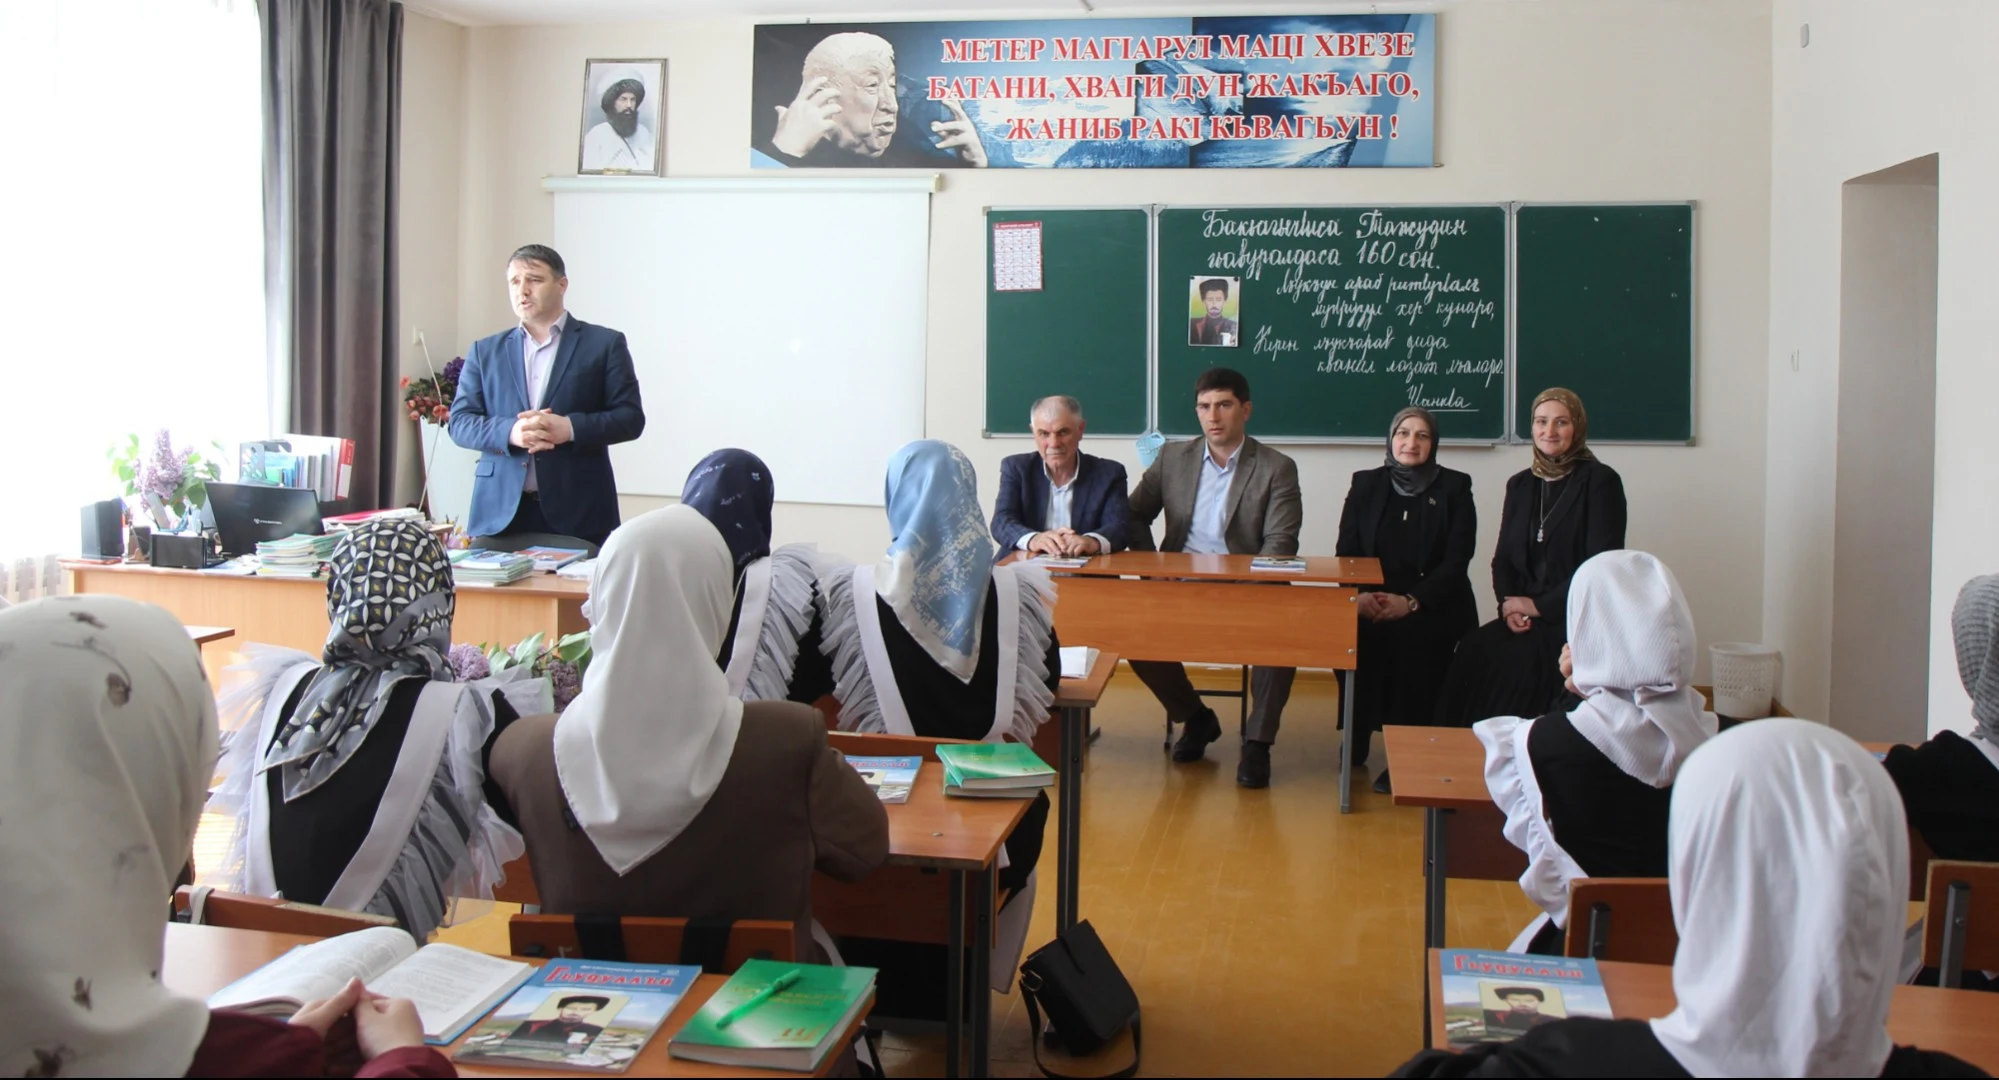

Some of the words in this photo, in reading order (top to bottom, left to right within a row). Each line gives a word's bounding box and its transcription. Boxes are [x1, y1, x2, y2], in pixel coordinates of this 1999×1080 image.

[941, 38, 1046, 62] МЕТЕР
[1313, 33, 1414, 58] ХВЕЗЕ
[927, 76, 1056, 102] БАТАНИ,
[1063, 74, 1167, 98] ХВАГИ
[1172, 73, 1242, 104] ДУН
[1247, 72, 1420, 101] ЖАКЪАГО,
[1005, 116, 1122, 141] ЖАНИБ
[1356, 209, 1468, 250] Тажудин
[1356, 240, 1396, 265] 160
[1398, 250, 1441, 270] сон.
[1344, 272, 1384, 302] араб
[1395, 301, 1423, 326] хер
[1406, 335, 1449, 360] дида
